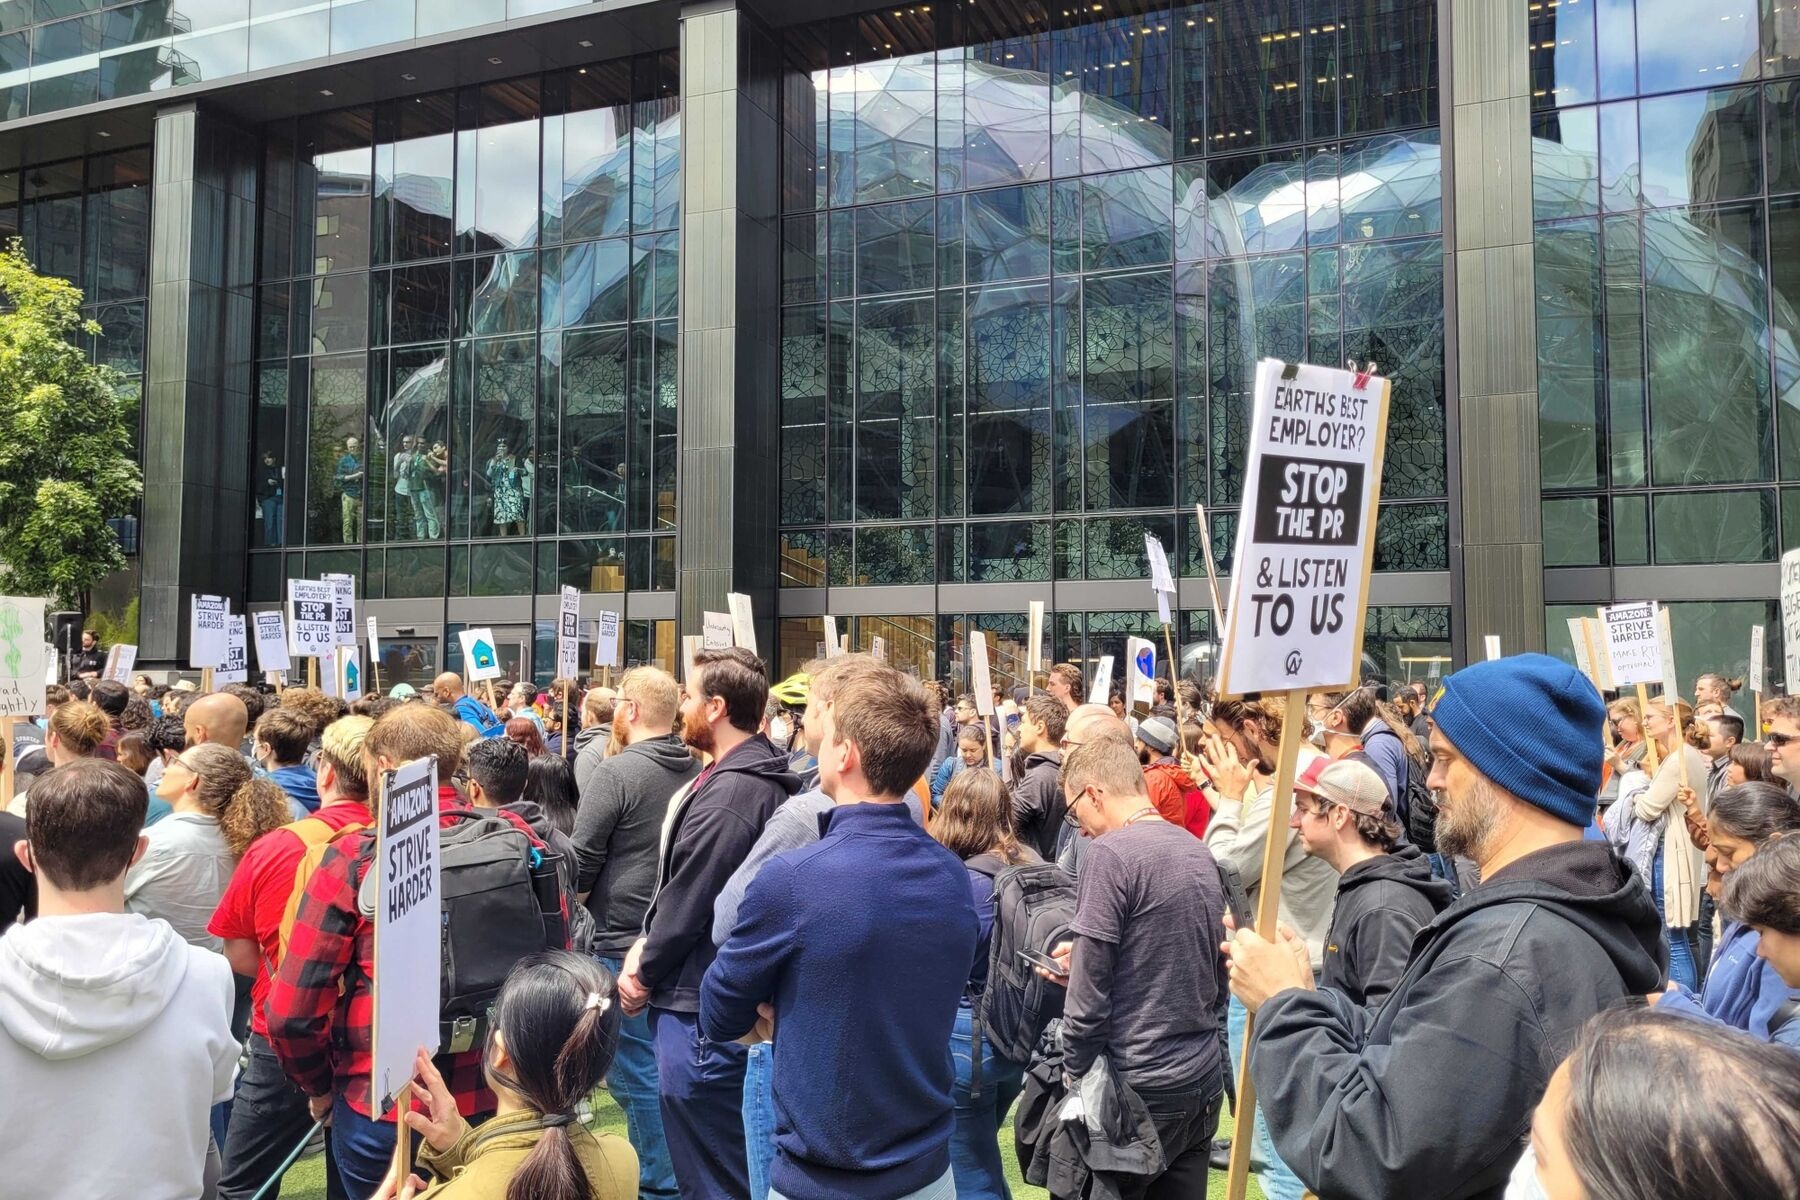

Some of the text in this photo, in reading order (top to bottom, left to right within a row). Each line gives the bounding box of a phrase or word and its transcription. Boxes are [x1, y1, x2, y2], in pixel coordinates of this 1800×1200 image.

[1274, 386, 1368, 421] EARTH'S BEST
[1269, 415, 1366, 452] EMPLOYER?
[1281, 462, 1347, 504] STOP
[1276, 506, 1345, 539] THE PR
[1256, 557, 1348, 589] & LISTEN
[300, 602, 325, 612] STOP
[198, 611, 224, 621] STRIVE
[300, 611, 314, 620] THE
[1251, 592, 1345, 638] TO US
[198, 620, 225, 630] HARDER
[303, 623, 330, 631] LISTEN
[1611, 620, 1653, 634] STRIVE
[296, 631, 330, 642] TO US
[1612, 630, 1655, 643] HARDER
[1612, 648, 1637, 659] MAKE
[0, 680, 21, 696] ad
[388, 825, 431, 883] STRIVE
[388, 864, 432, 923] HARDER
